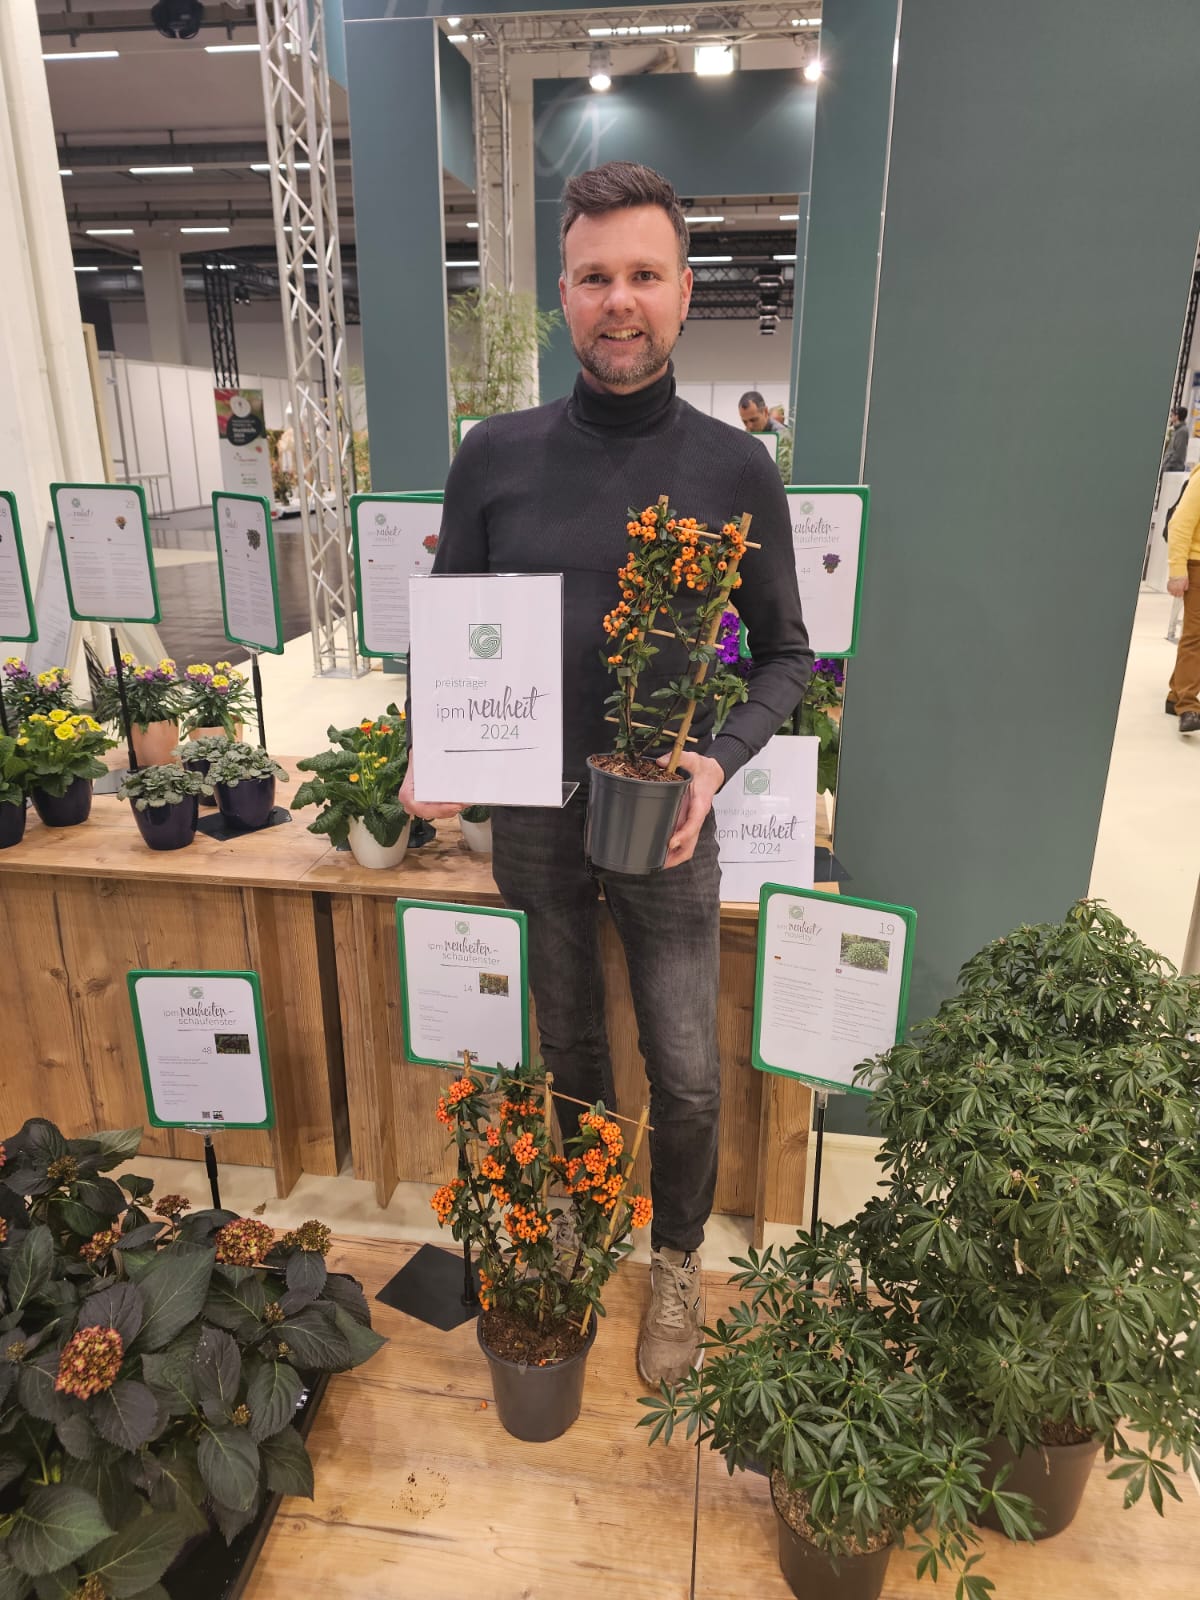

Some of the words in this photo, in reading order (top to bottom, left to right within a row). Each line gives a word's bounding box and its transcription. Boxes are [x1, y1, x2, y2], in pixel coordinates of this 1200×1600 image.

[436, 703, 465, 722] ipm
[467, 685, 551, 721] neuheit
[480, 723, 520, 740] 2024
[741, 814, 808, 841] neuheit
[750, 841, 783, 855] 2024
[879, 922, 895, 936] 19
[442, 952, 501, 966] schaufenster
[463, 984, 473, 993] 14
[178, 1017, 236, 1026] schaufenster
